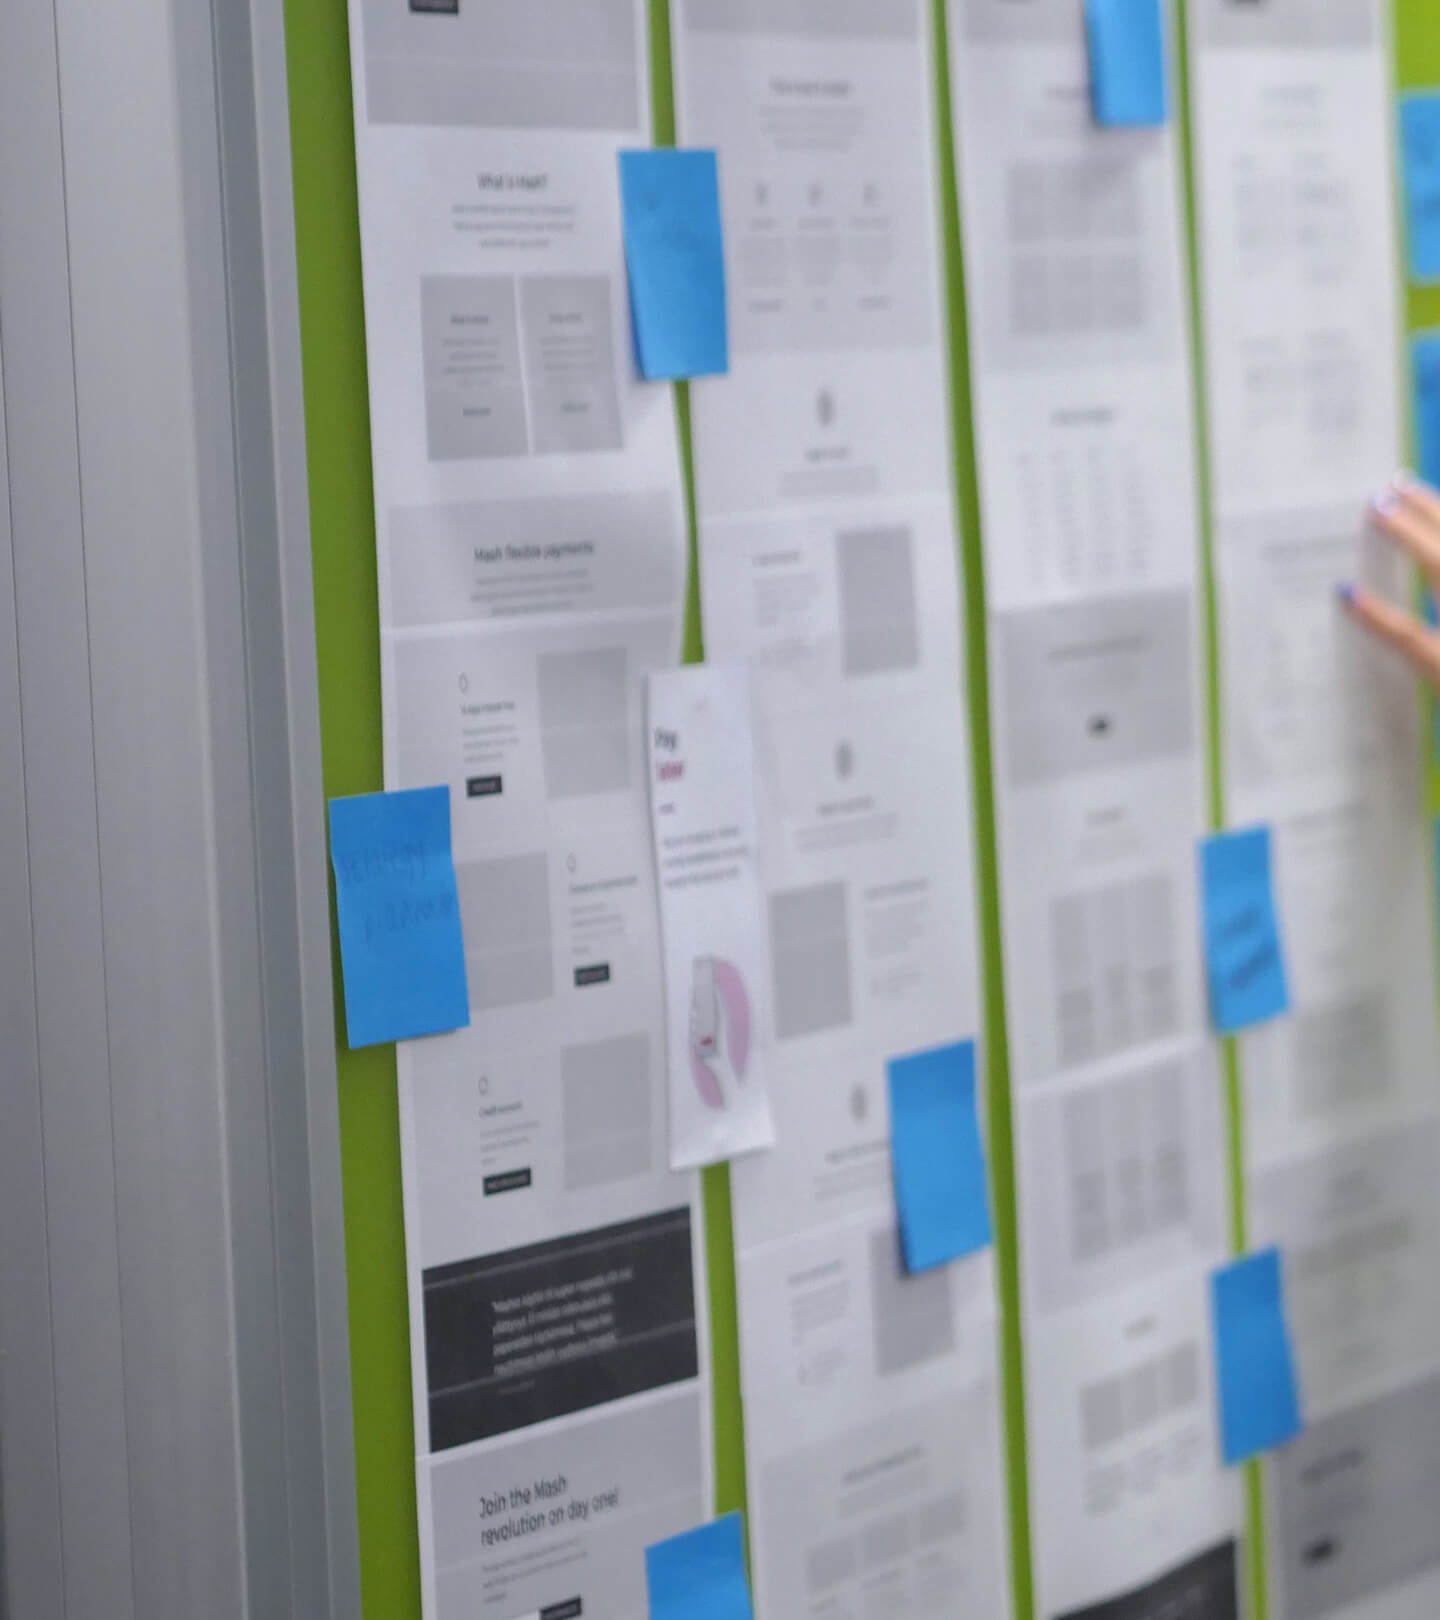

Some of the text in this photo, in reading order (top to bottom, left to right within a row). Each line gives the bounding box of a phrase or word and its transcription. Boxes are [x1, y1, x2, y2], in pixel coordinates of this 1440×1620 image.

[479, 1473, 567, 1519] Join the Mash
[480, 1512, 546, 1547] revolution
[549, 1506, 565, 1526] on
[568, 1498, 589, 1521] day
